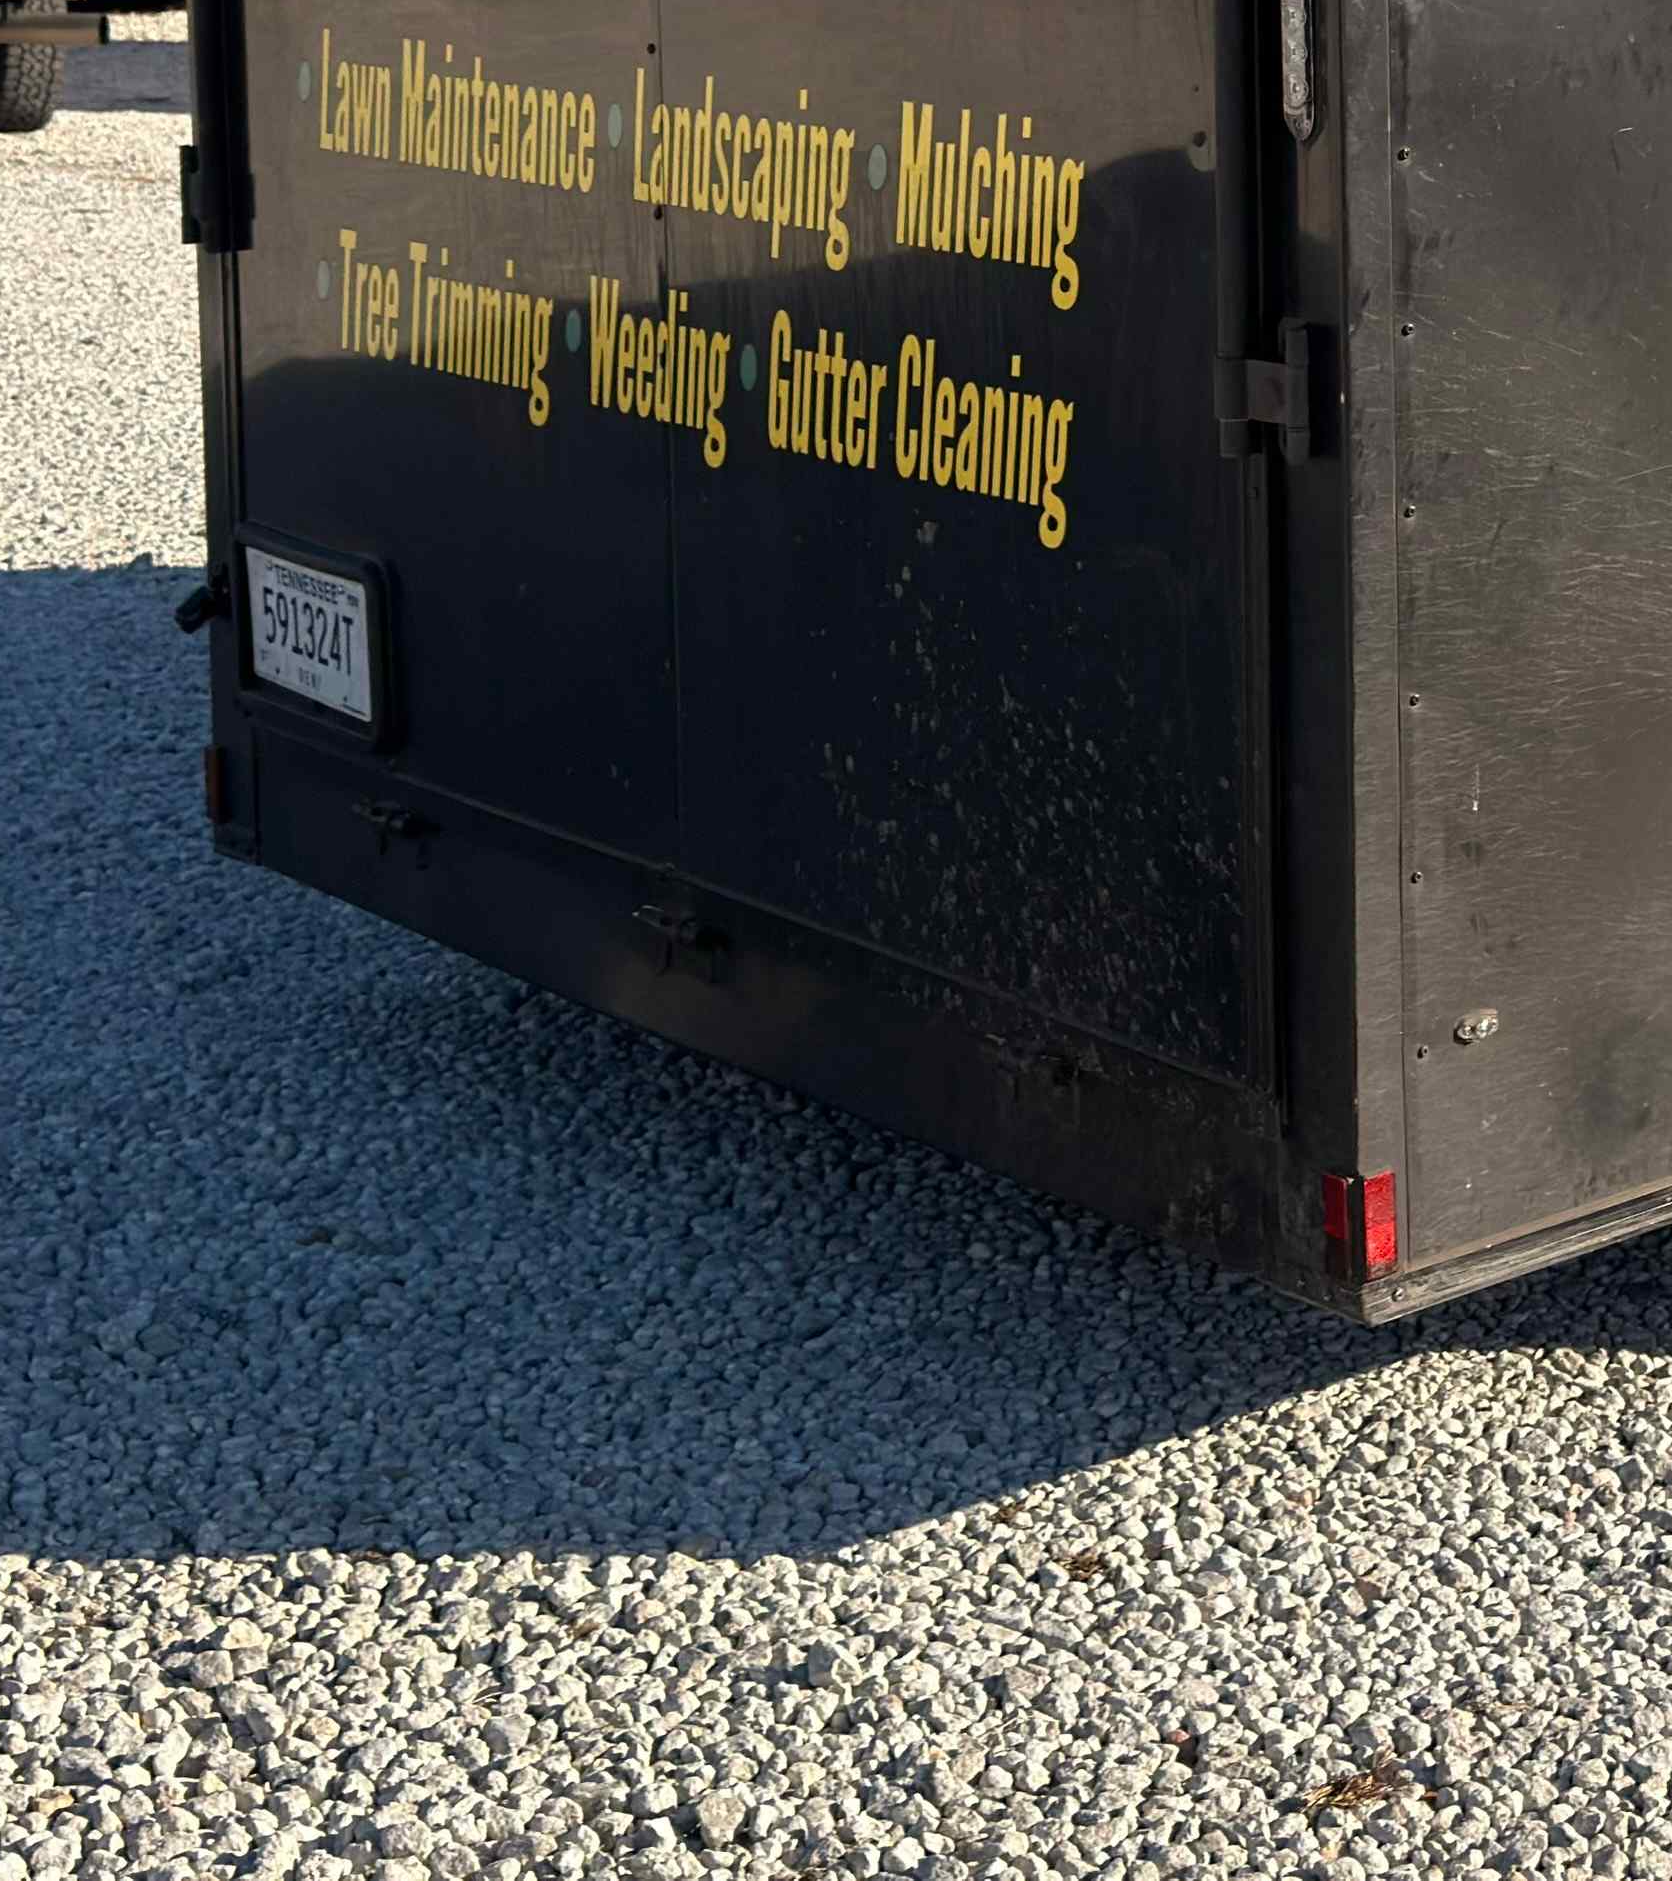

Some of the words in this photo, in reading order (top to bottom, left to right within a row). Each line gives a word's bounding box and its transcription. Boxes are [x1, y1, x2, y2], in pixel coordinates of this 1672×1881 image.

[319, 27, 392, 161] Lawn
[399, 38, 596, 193] Maintenance
[633, 67, 855, 272] Landscaping
[895, 100, 1085, 311] Mulching
[339, 228, 400, 362] Tree
[409, 241, 554, 428] Trimming
[589, 275, 731, 469] Weeding
[767, 309, 888, 470] Gutter
[895, 333, 1075, 550] Cleaning
[263, 586, 354, 678] 591324T
[276, 565, 339, 606] TENNESSEE
